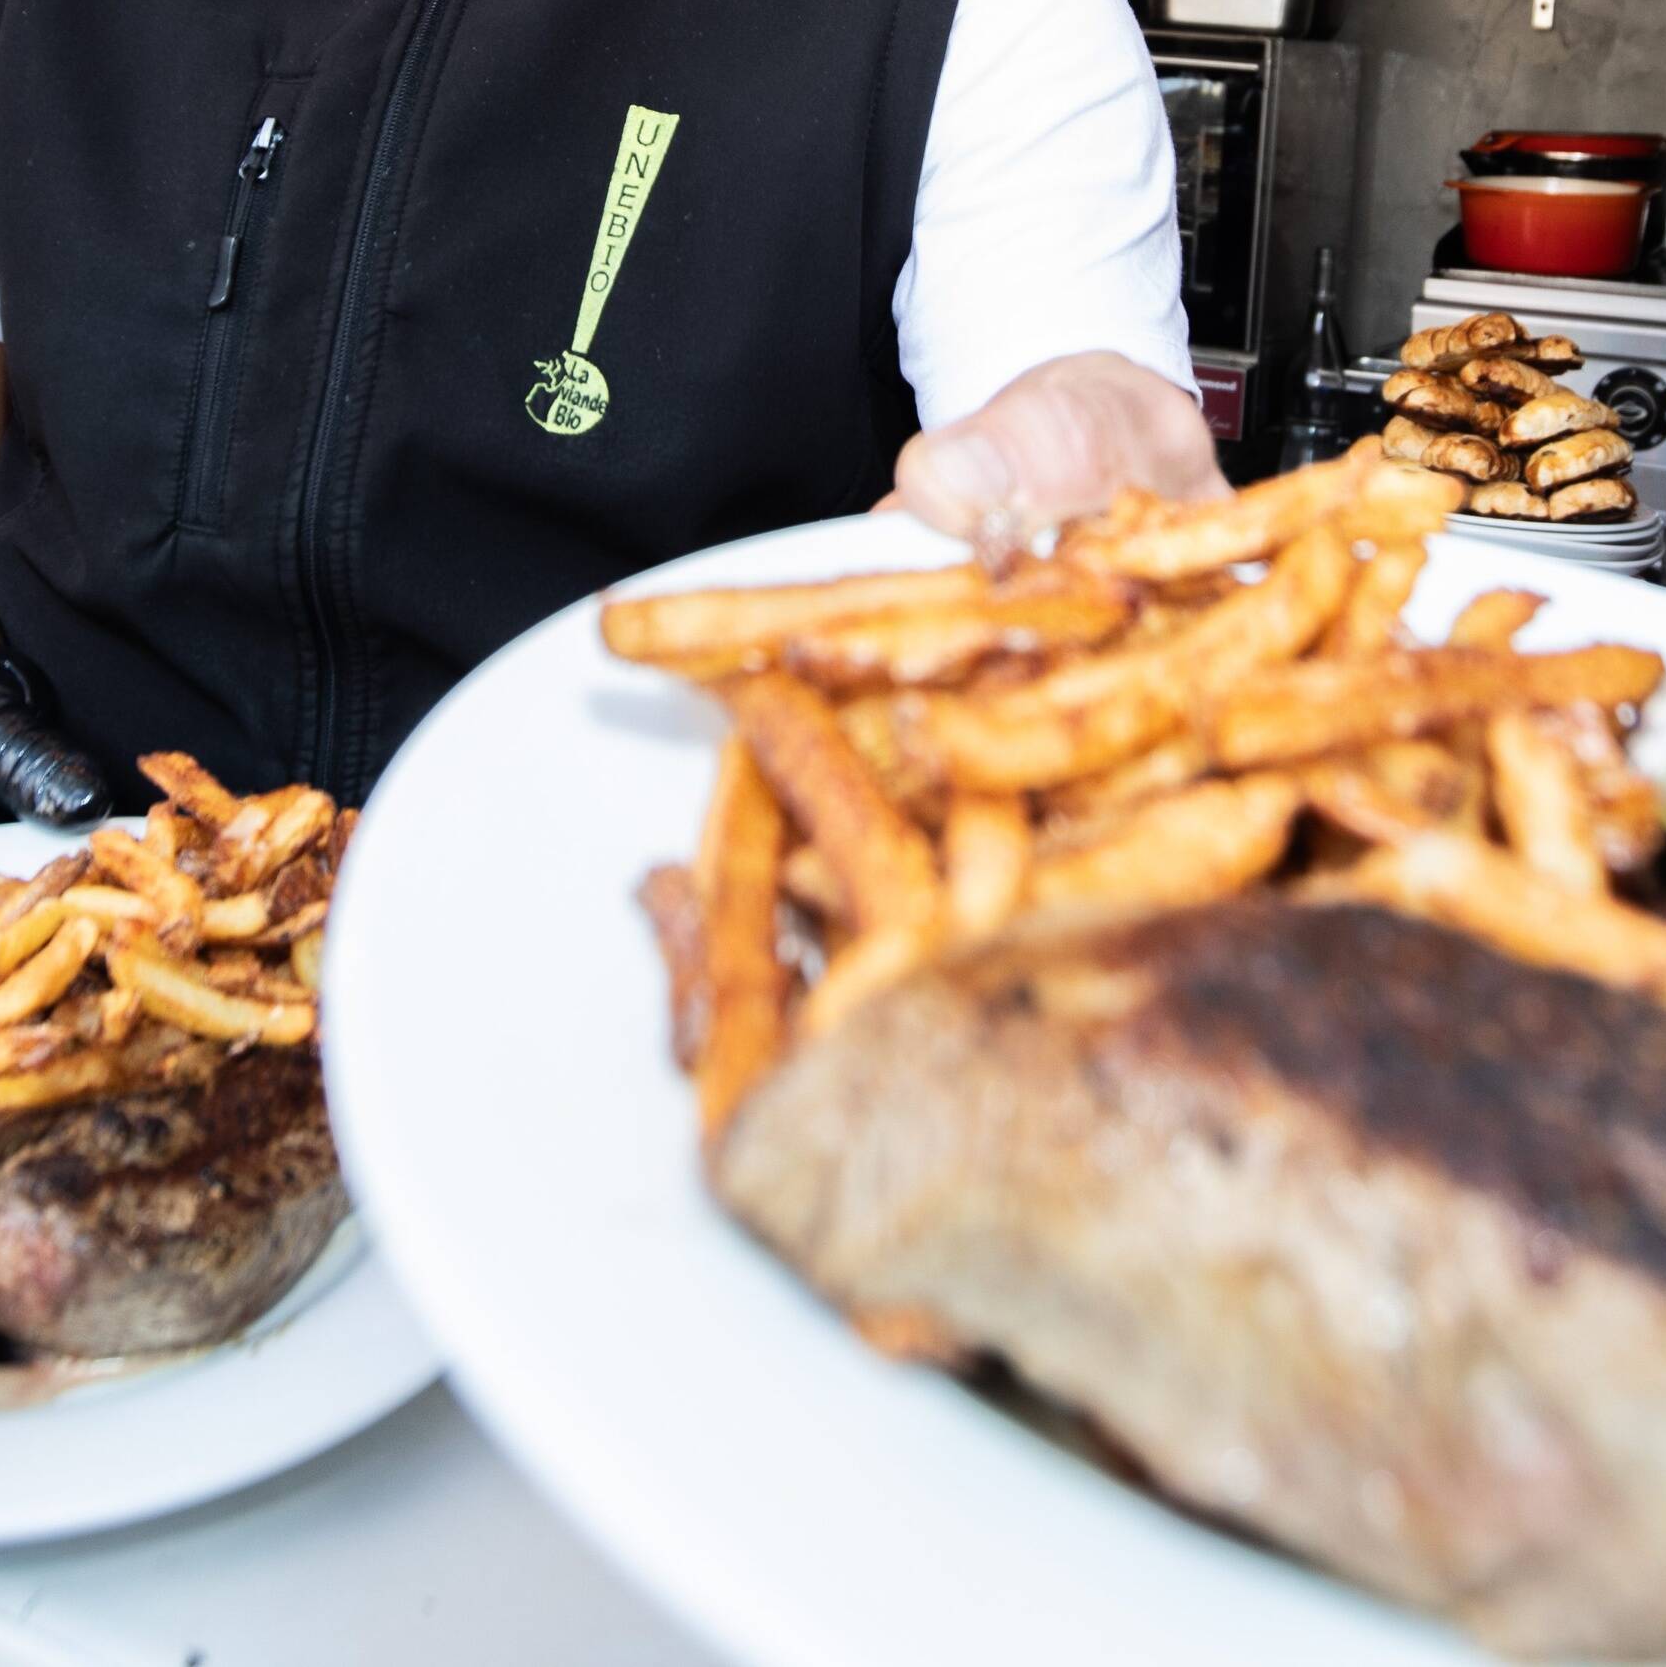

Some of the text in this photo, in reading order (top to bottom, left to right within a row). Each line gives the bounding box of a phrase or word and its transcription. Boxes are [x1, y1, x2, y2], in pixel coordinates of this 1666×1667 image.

[590, 119, 661, 293] UNEBIO
[569, 360, 590, 384] La
[553, 404, 582, 431] Bio
